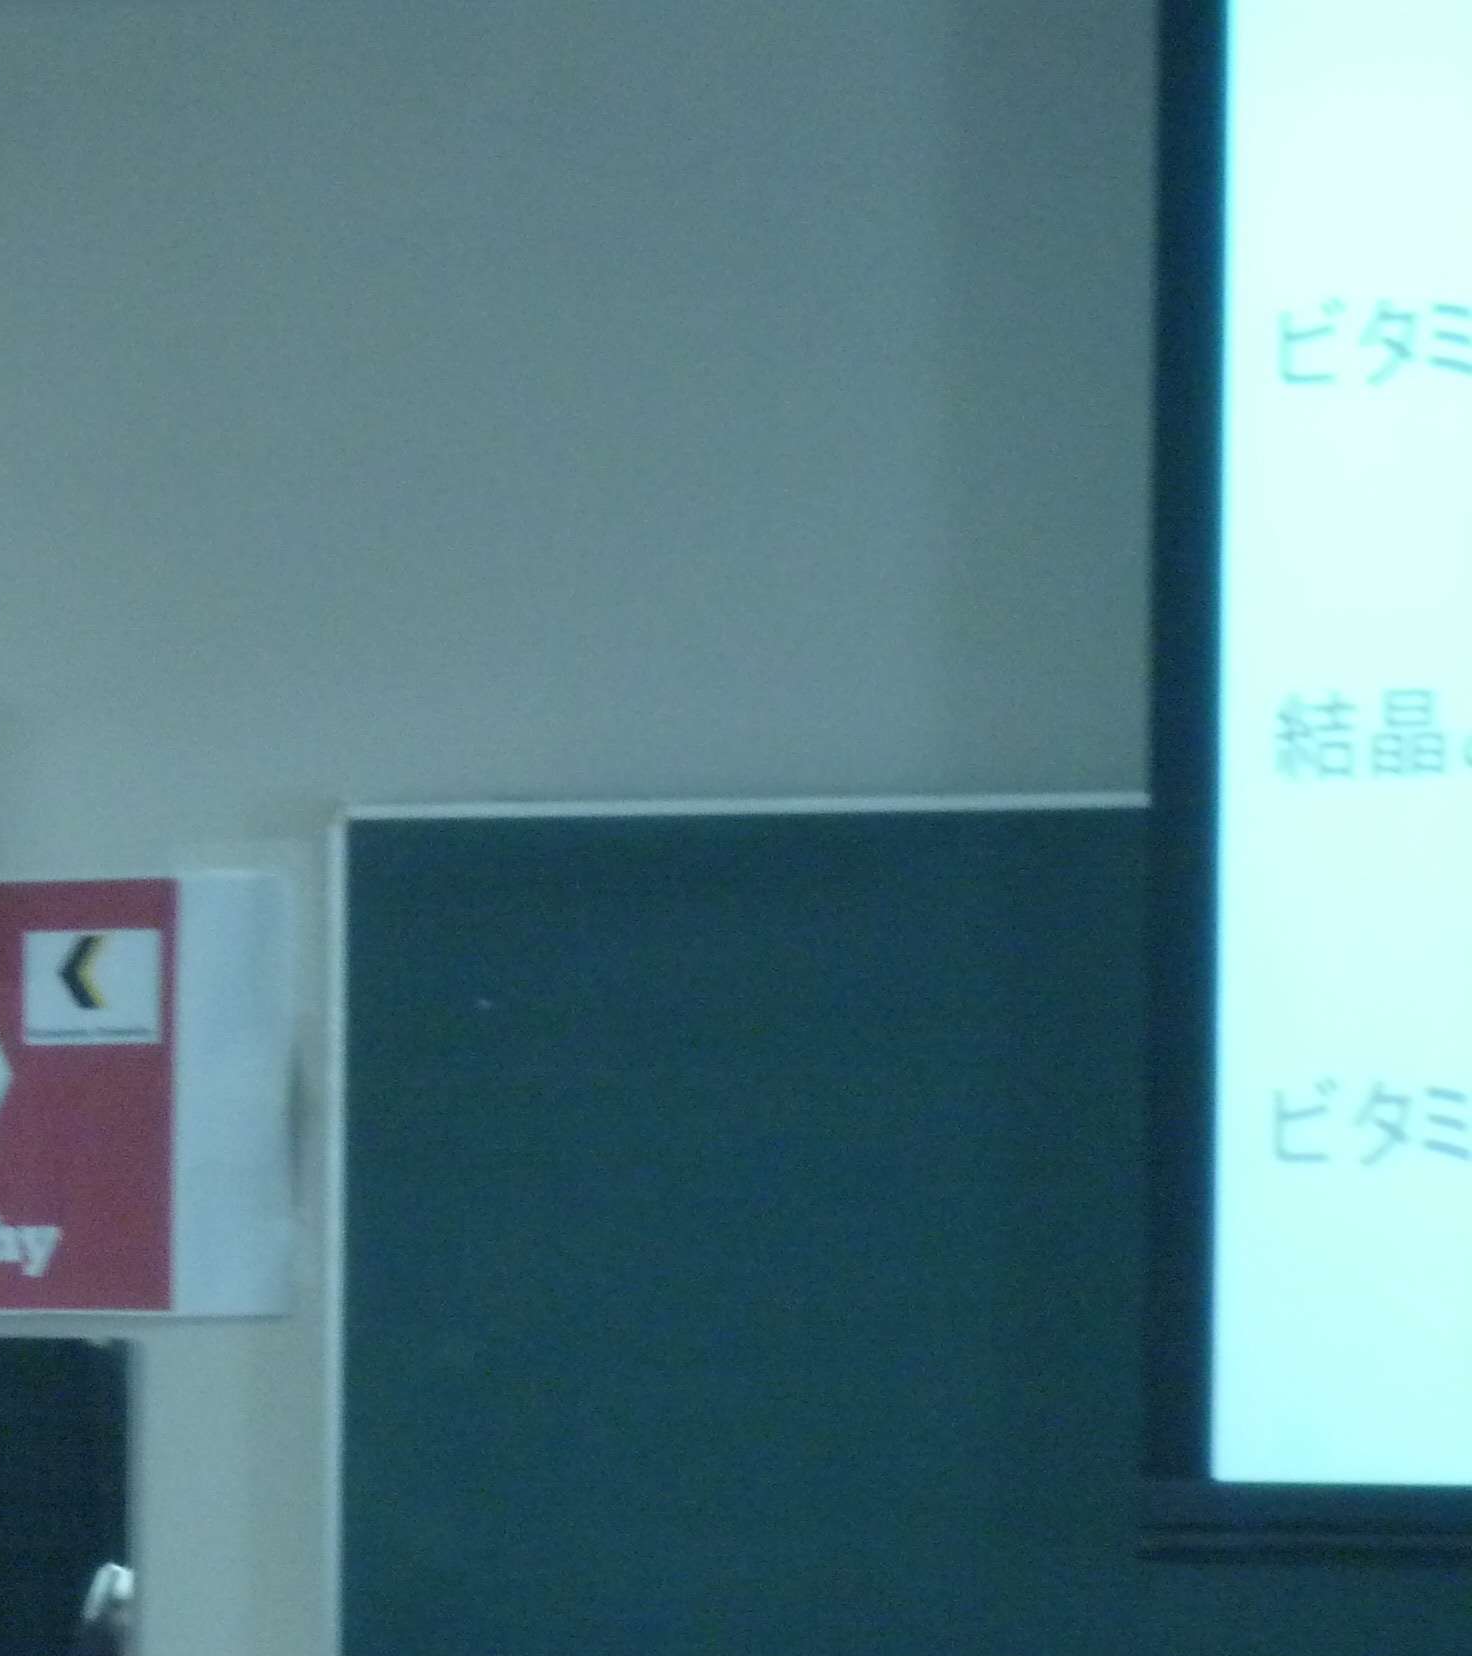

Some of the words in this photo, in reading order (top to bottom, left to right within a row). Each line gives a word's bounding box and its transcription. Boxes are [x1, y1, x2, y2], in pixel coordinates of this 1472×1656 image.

[1276, 297, 1472, 387] ビタミ
[1274, 688, 1472, 780] 結晶
[1269, 1077, 1472, 1167] ビタミ
